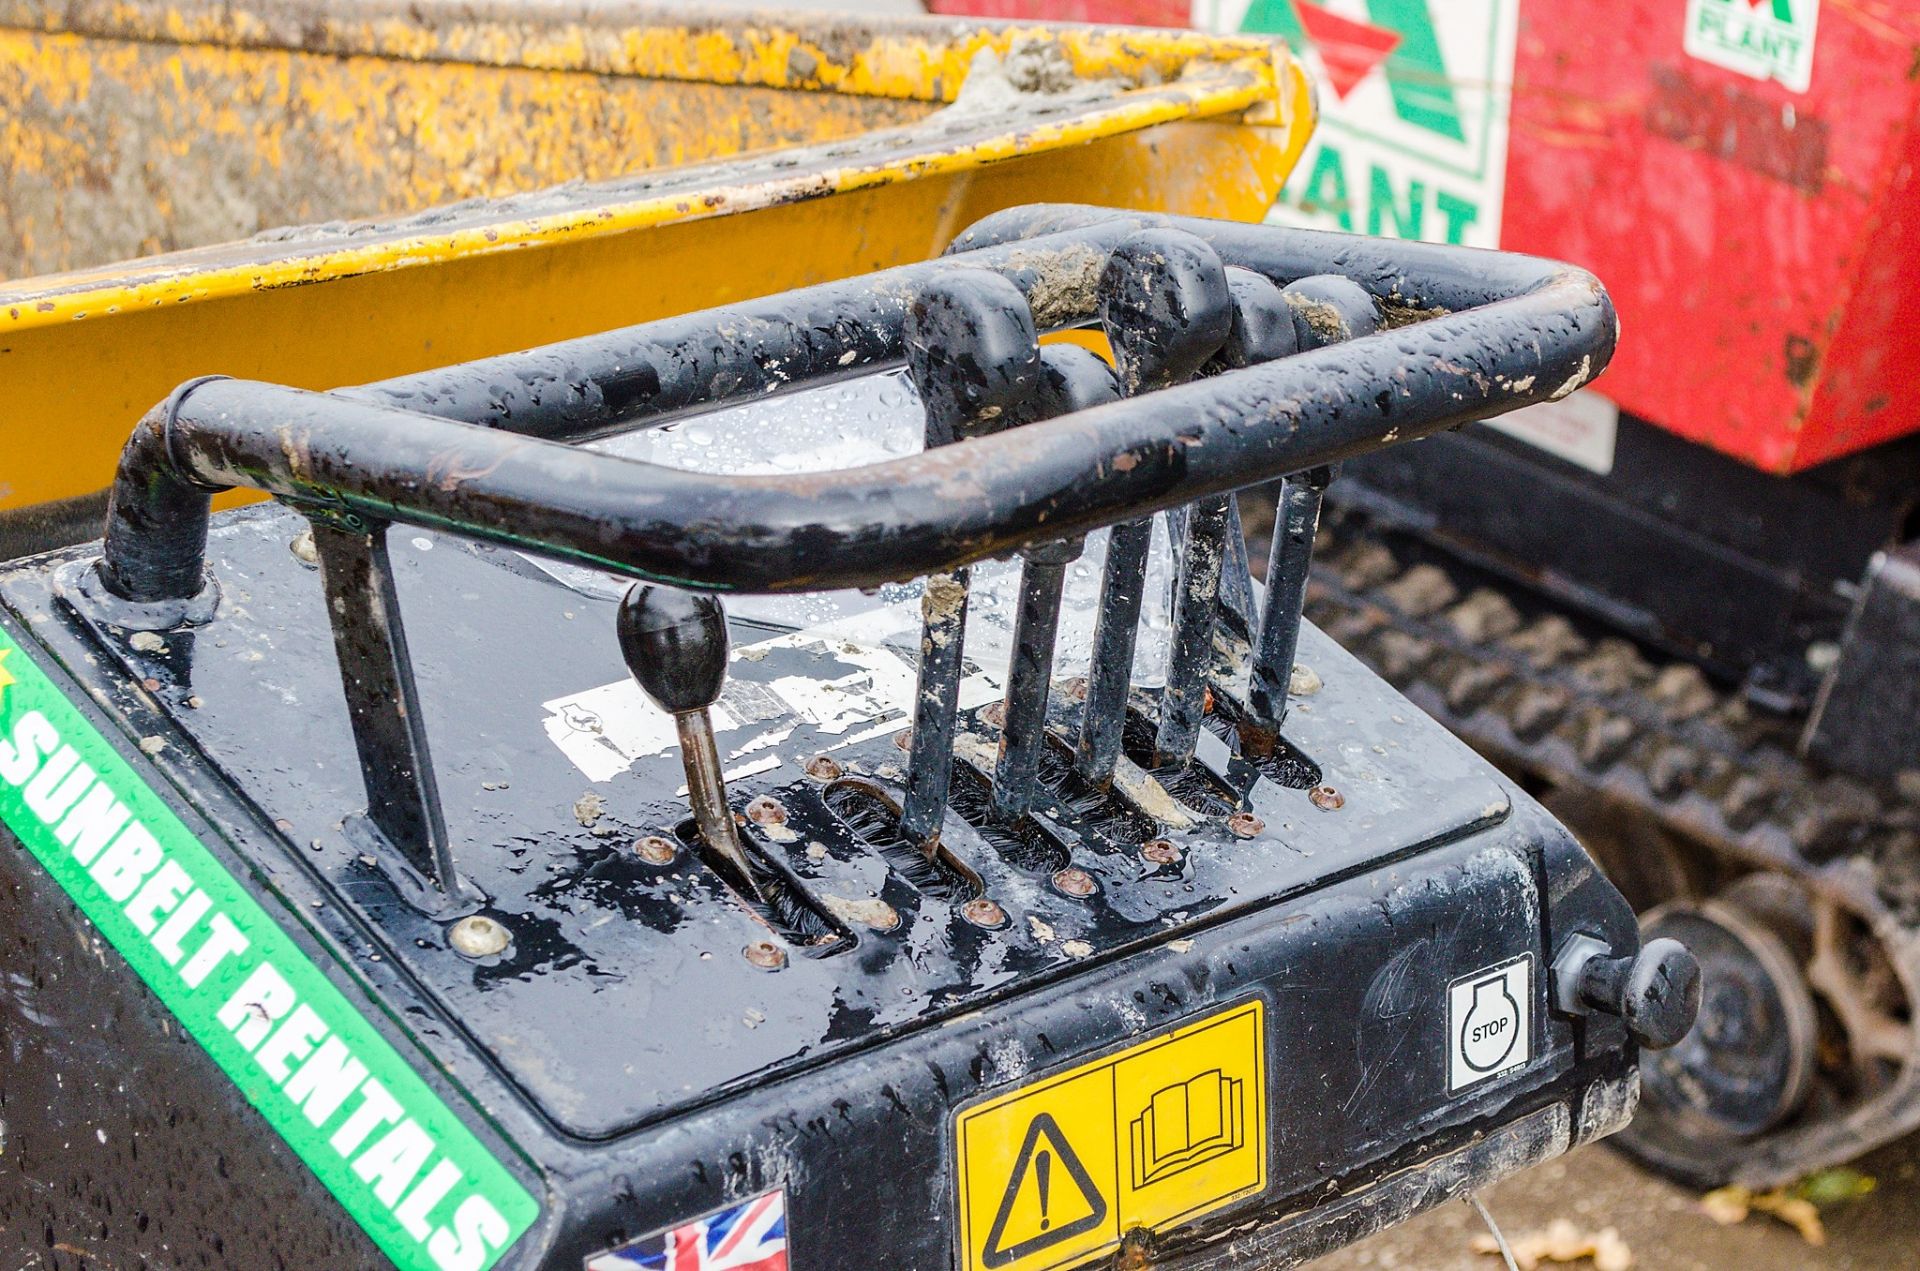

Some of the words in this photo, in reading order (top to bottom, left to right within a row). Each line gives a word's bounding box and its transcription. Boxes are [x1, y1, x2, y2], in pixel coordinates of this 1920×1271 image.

[1698, 6, 1801, 68] PLANT
[1280, 145, 1478, 244] ANT
[0, 710, 249, 989] SUNBELT
[216, 961, 510, 1271] RENTALS
[1472, 1017, 1508, 1043] STOP
